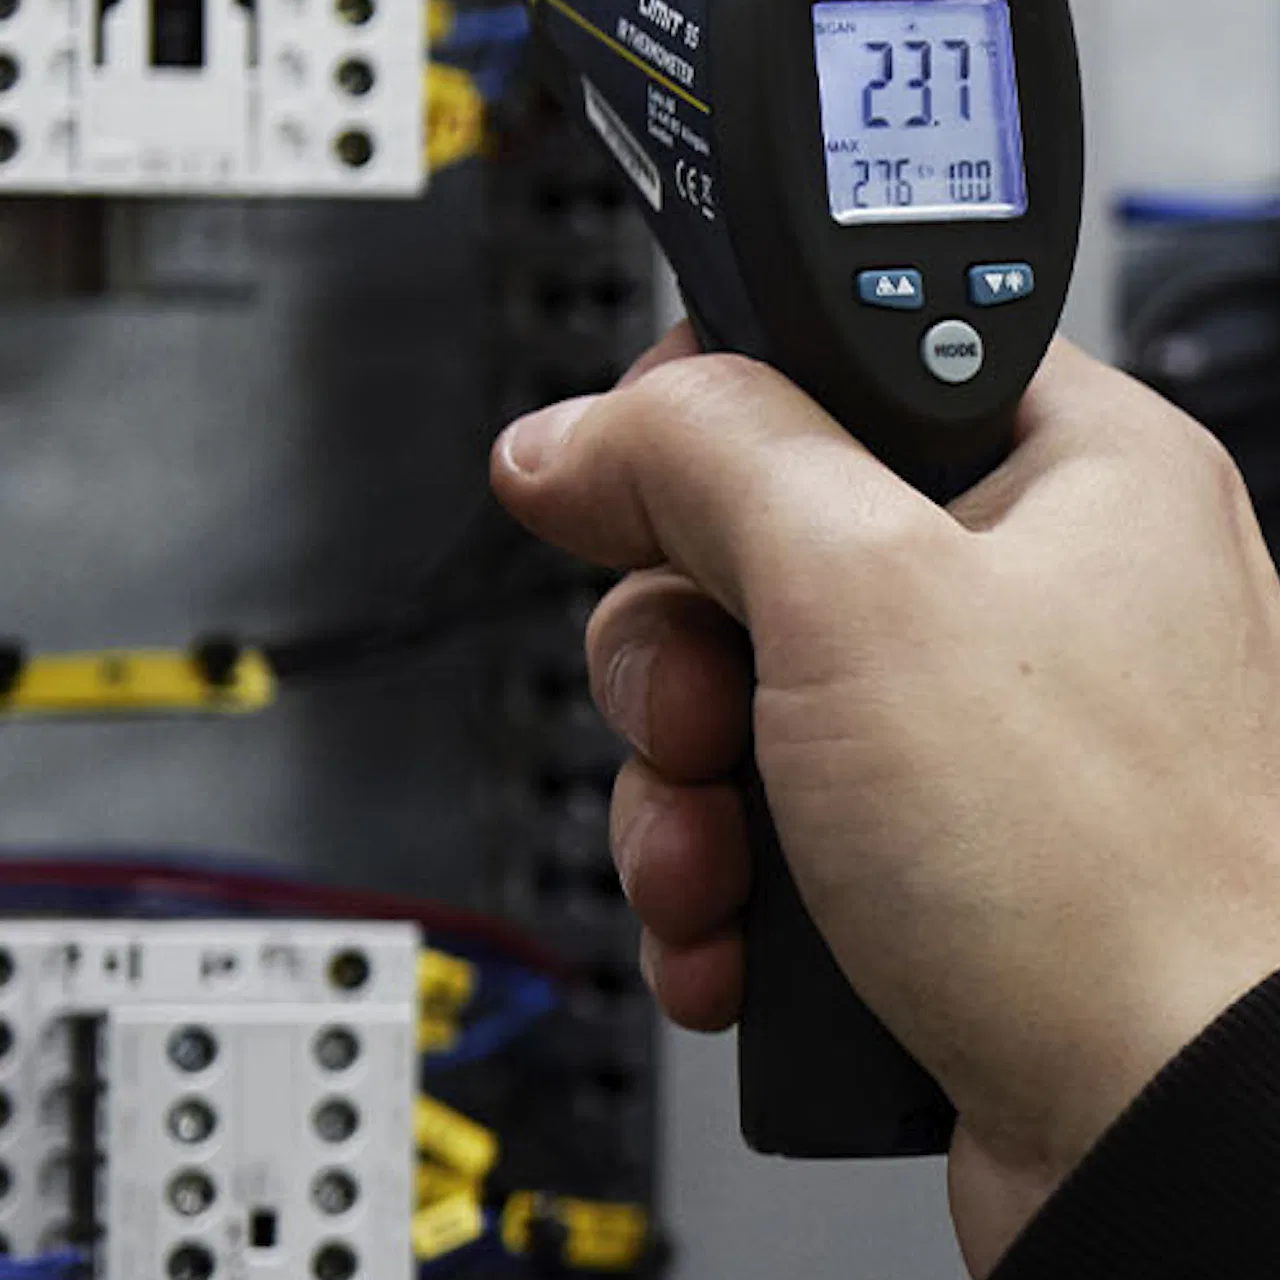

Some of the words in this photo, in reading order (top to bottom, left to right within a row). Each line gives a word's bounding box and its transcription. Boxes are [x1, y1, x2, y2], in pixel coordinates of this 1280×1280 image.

[815, 21, 857, 35] SCAN
[827, 139, 861, 153] MAX
[934, 342, 978, 359] MODE
